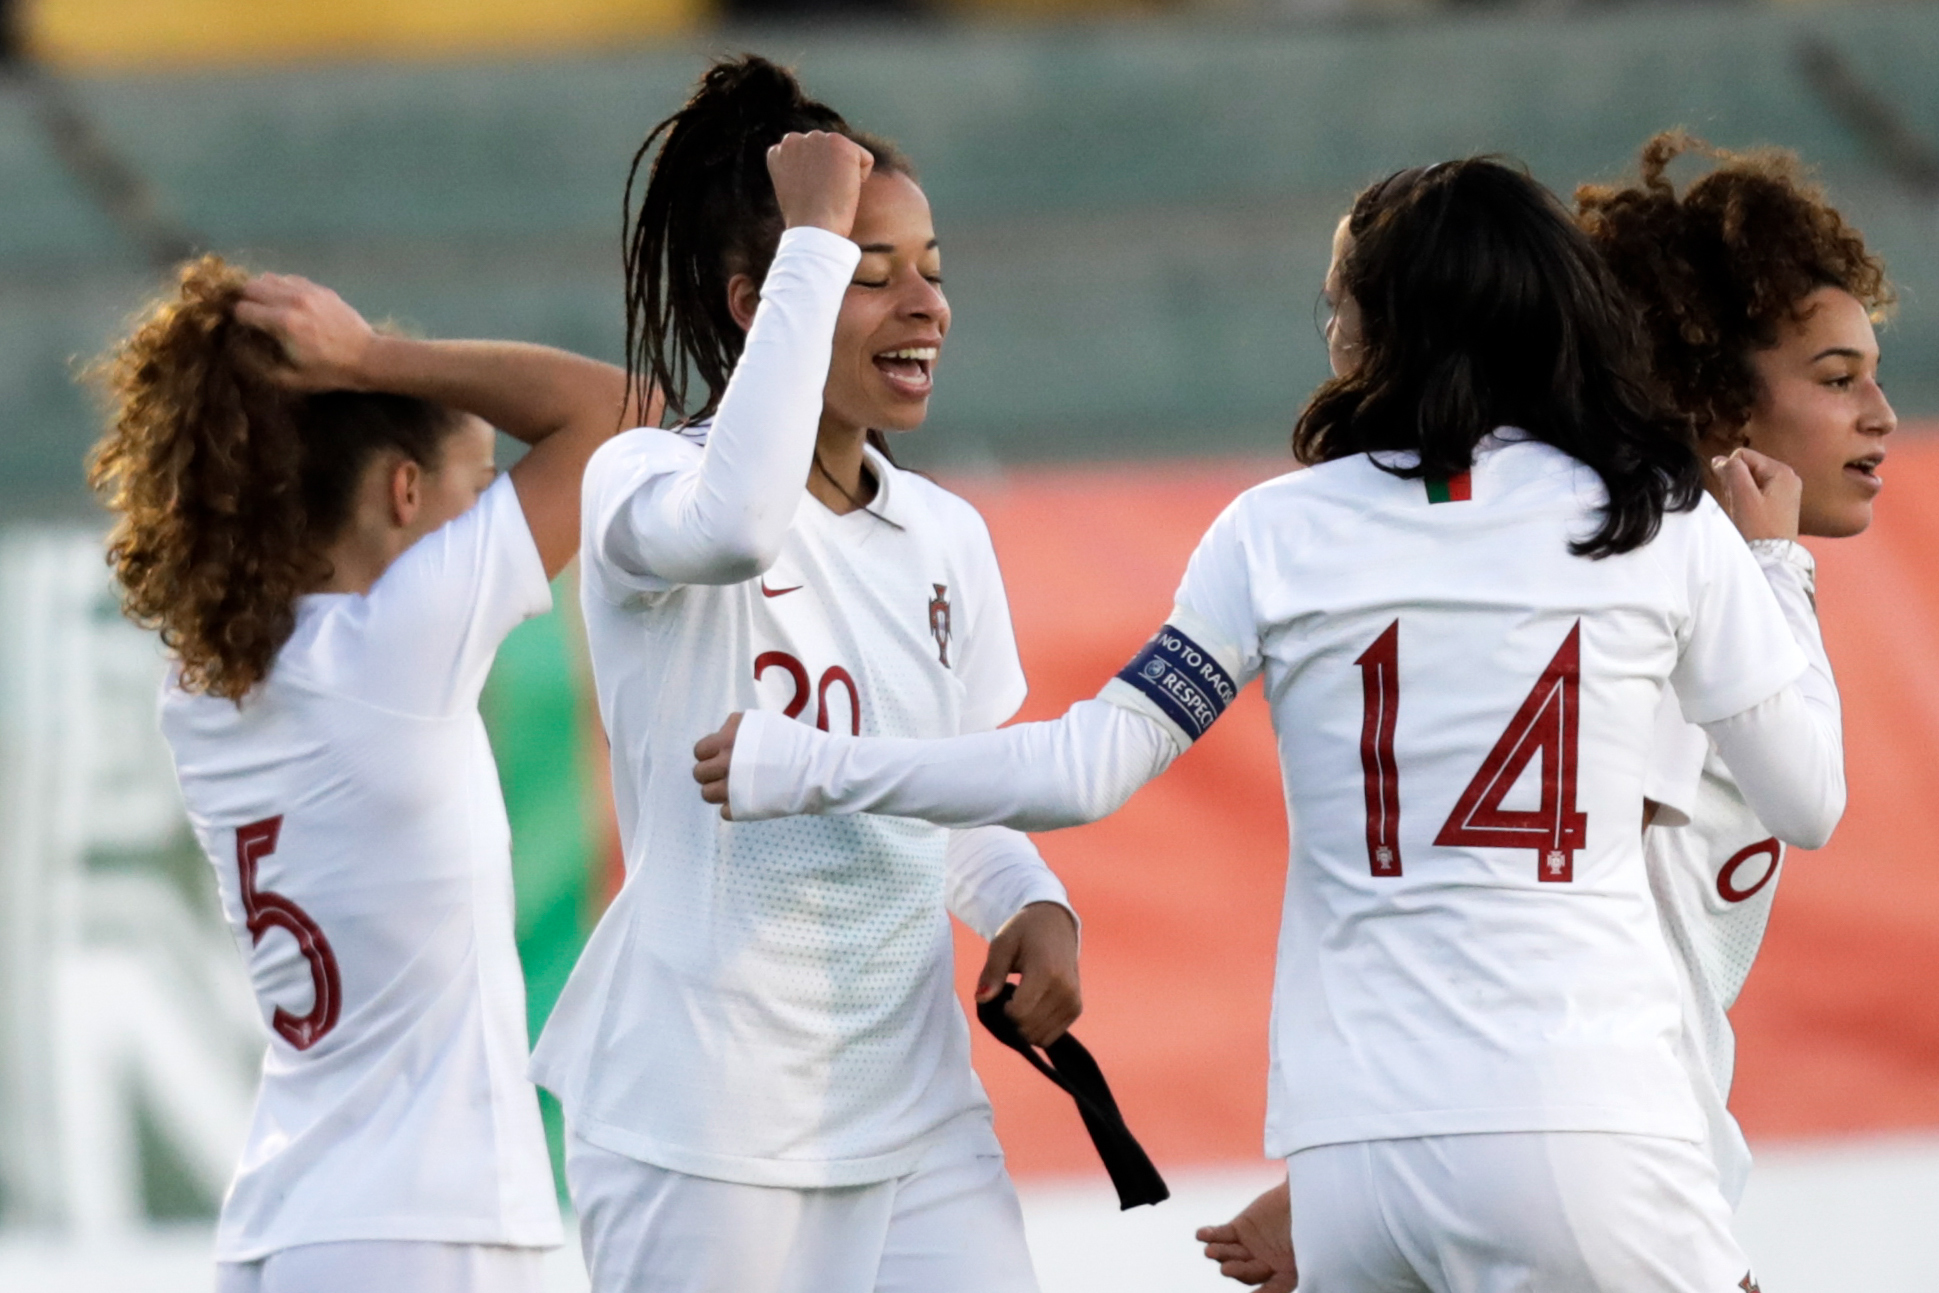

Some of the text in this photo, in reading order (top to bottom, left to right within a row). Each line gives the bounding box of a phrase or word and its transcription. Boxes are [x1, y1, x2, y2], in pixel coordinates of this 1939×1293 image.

[753, 650, 861, 736] 20
[1157, 633, 1234, 706] NO TO RACIS
[1162, 672, 1214, 729] RESPECT
[1353, 617, 1587, 882] 14
[235, 813, 342, 1051] 5
